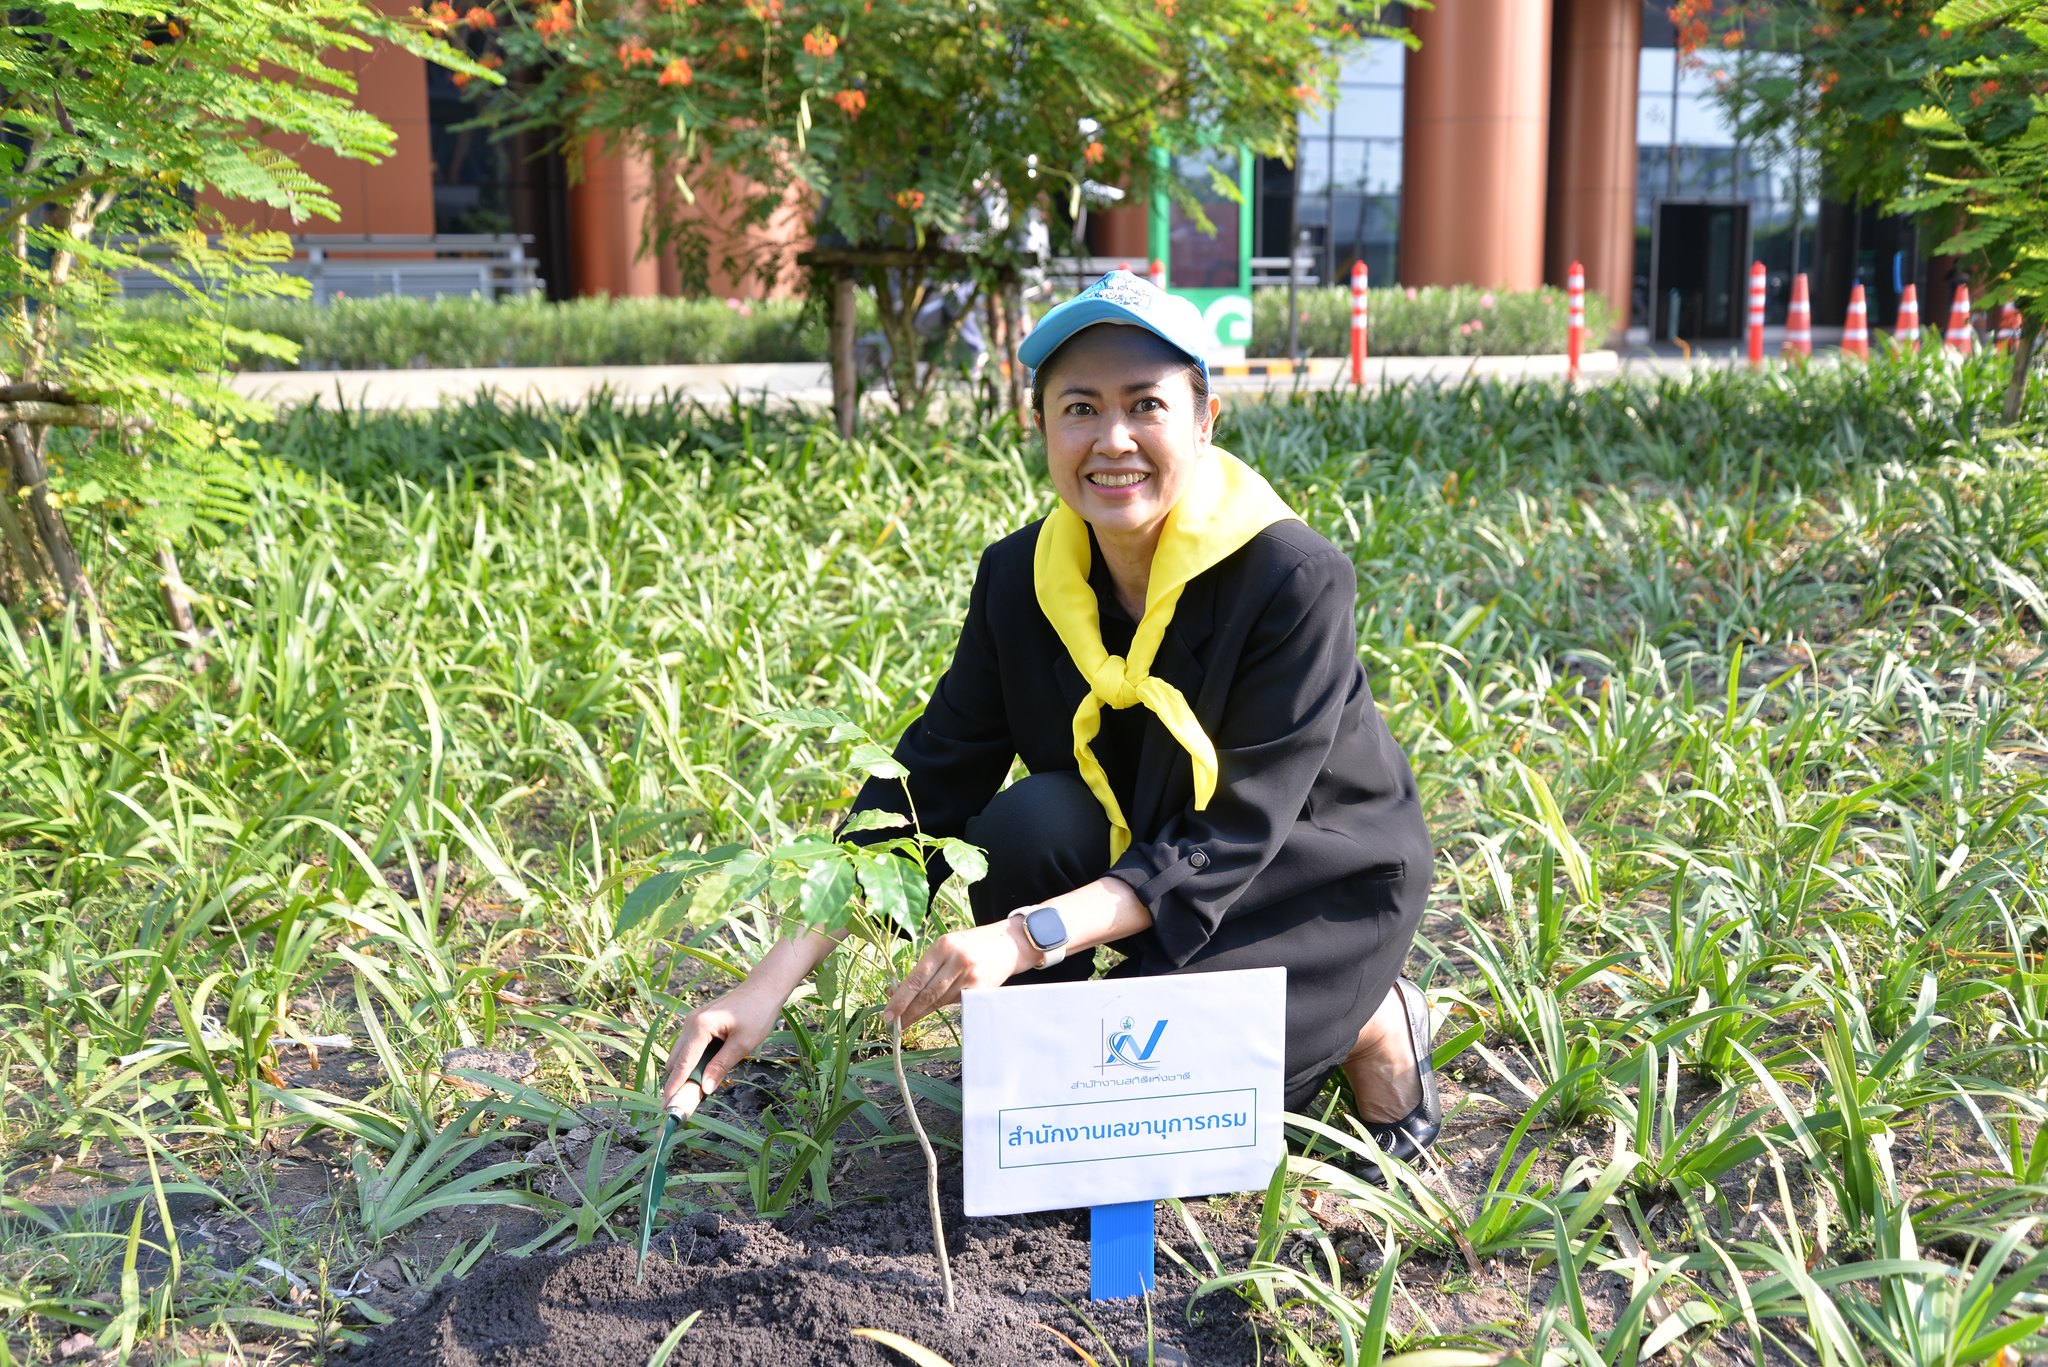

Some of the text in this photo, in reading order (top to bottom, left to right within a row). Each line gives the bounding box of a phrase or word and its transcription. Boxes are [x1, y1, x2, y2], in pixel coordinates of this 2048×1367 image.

[1007, 1111, 1248, 1147] สำนักงานเลขานุการกรม
